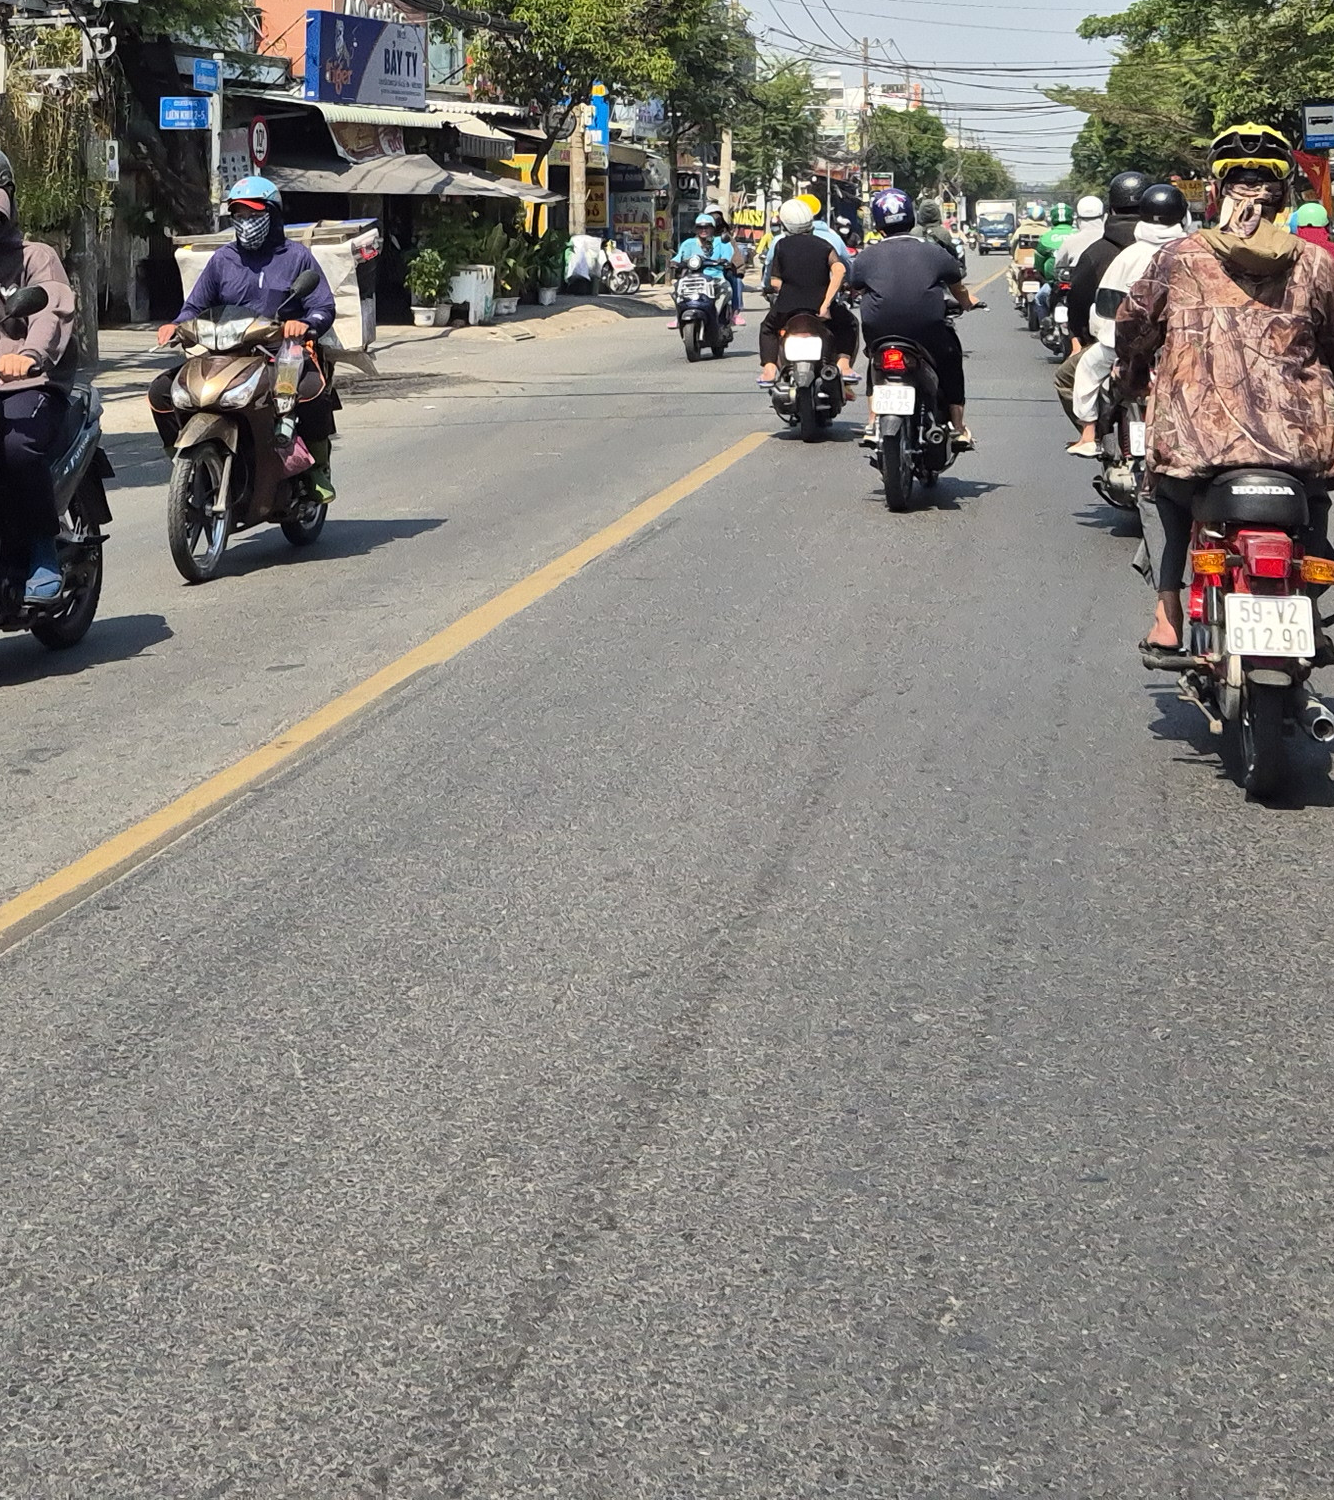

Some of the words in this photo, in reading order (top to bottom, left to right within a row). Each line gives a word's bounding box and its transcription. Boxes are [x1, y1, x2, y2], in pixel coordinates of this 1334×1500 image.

[1230, 485, 1296, 496] HONDA
[1238, 599, 1300, 626] 59-V2
[1233, 626, 1308, 652] 812.90
